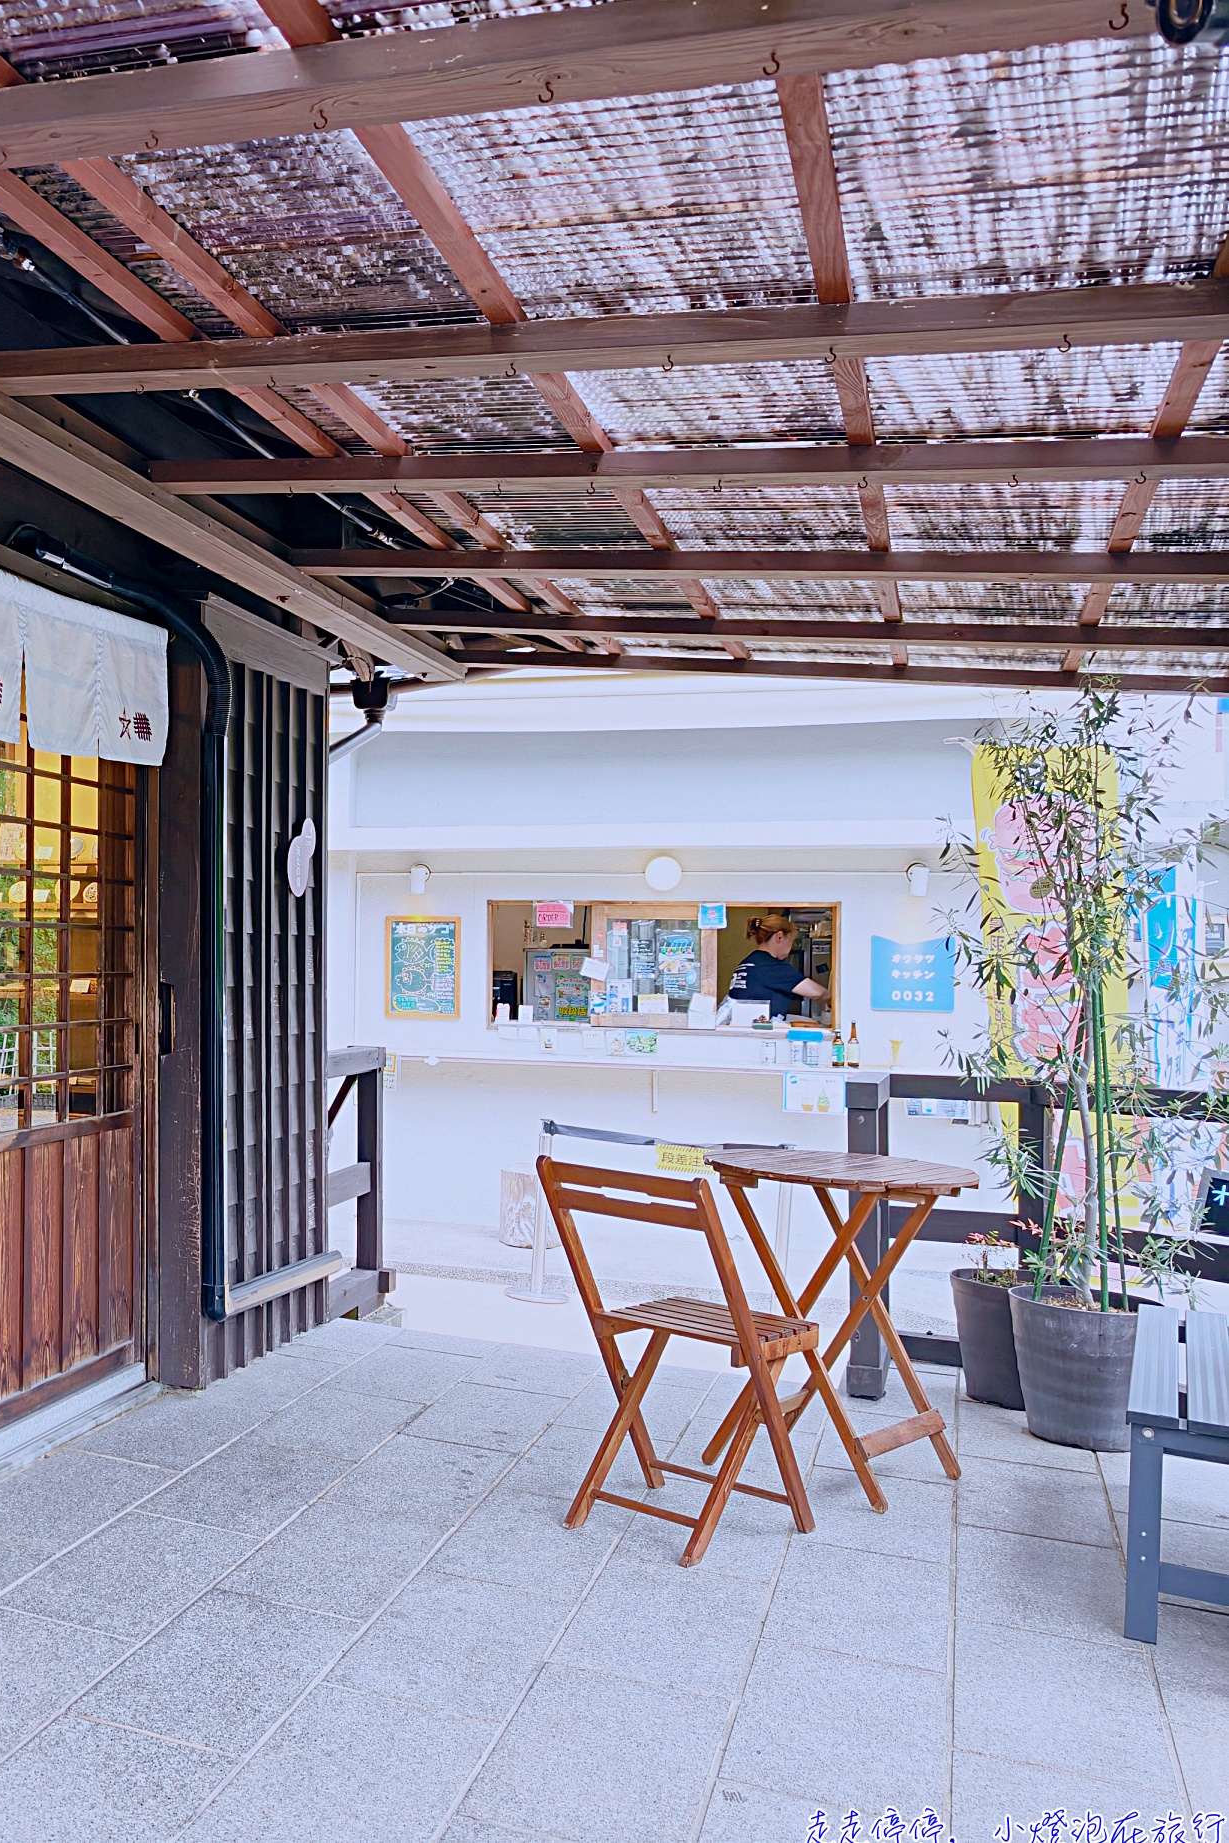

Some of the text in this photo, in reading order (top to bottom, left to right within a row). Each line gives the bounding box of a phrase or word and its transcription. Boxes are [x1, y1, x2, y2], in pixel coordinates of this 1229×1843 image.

[891, 969, 935, 980] キッチン
[891, 990, 935, 1002] 0032
[661, 1151, 711, 1168] 段差注
